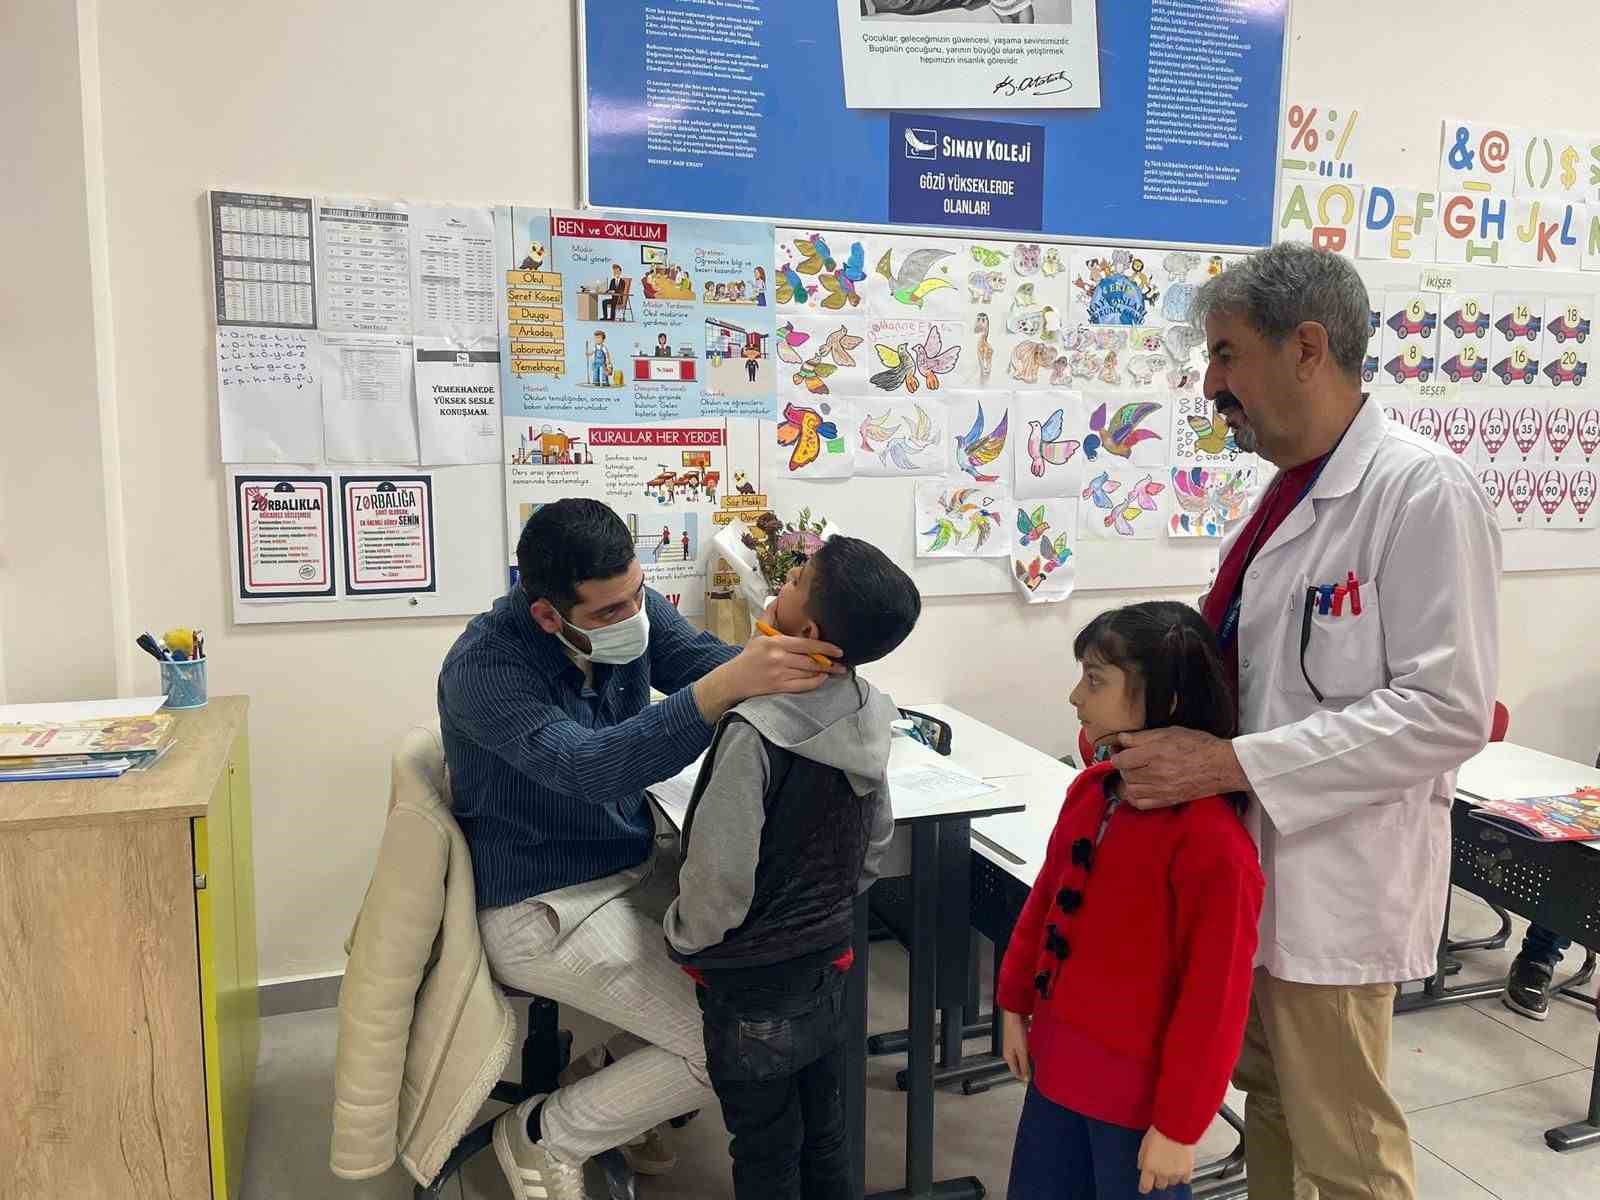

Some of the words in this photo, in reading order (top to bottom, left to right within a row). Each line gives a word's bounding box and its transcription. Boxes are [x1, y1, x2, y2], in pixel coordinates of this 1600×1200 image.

[1000, 47, 1024, 55] olarak
[943, 136, 982, 159] SINAV
[986, 139, 1031, 163] KOLEJİ
[920, 172, 945, 190] GÖZÜ
[948, 174, 1015, 195] YÜKSEKLERDE
[944, 198, 990, 215] OLANLAR!
[558, 221, 584, 234] BEN
[588, 226, 600, 234] ve
[604, 223, 660, 239] OKULUM
[523, 272, 544, 284] Okul
[521, 308, 549, 323] Duygu
[1412, 302, 1420, 315] 6
[1465, 302, 1477, 316] 10
[1517, 306, 1528, 320] 14
[1567, 308, 1577, 322] 18
[511, 343, 562, 354] Laboratuvar
[1409, 346, 1417, 360] 8
[1464, 348, 1475, 361] 12
[1514, 350, 1526, 364] 16
[1563, 352, 1576, 366] 20
[514, 361, 560, 373] Yemekhane
[434, 395, 467, 405] YÜKSEK
[468, 396, 494, 405] SESLE
[1419, 425, 1432, 435] 20
[1454, 424, 1466, 435] 25
[1488, 424, 1501, 435] 30
[1521, 424, 1533, 434] 35
[1554, 424, 1567, 434] 40
[1585, 425, 1597, 436] 45
[591, 431, 652, 443] KURALLAR
[656, 432, 679, 443] HER
[684, 432, 719, 443] YERDE
[1516, 485, 1527, 496] 85
[1545, 486, 1558, 496] 90
[1578, 486, 1589, 497] 95
[398, 512, 420, 525] SENİN
